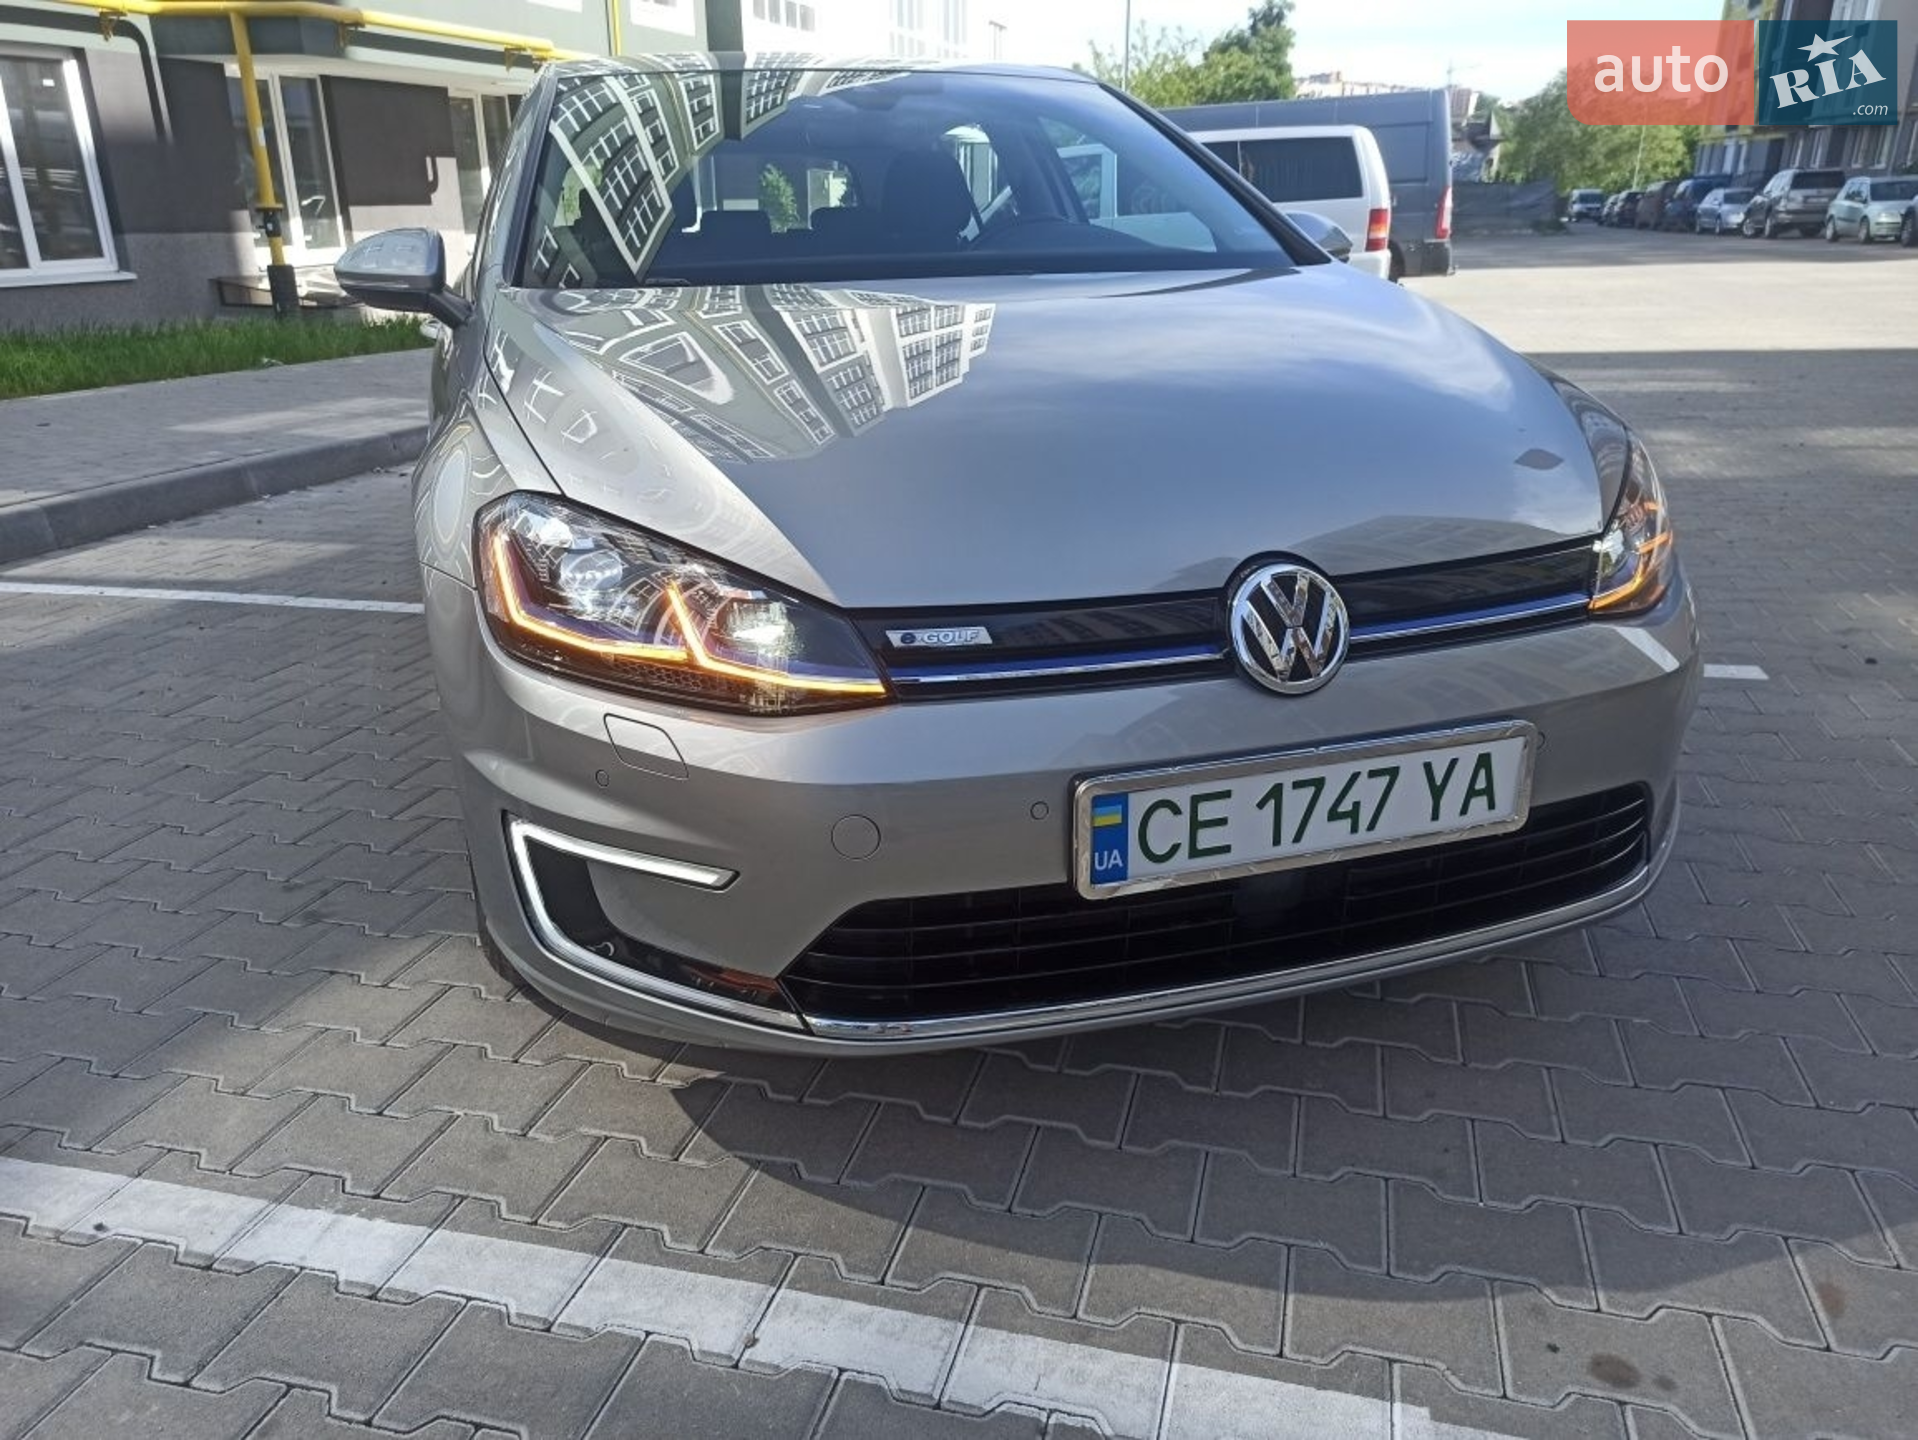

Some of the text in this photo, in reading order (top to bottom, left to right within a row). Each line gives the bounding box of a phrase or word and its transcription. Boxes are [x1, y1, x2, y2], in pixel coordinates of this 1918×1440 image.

[1138, 752, 1496, 864] CE 1747 YA
[1095, 849, 1123, 870] UA
